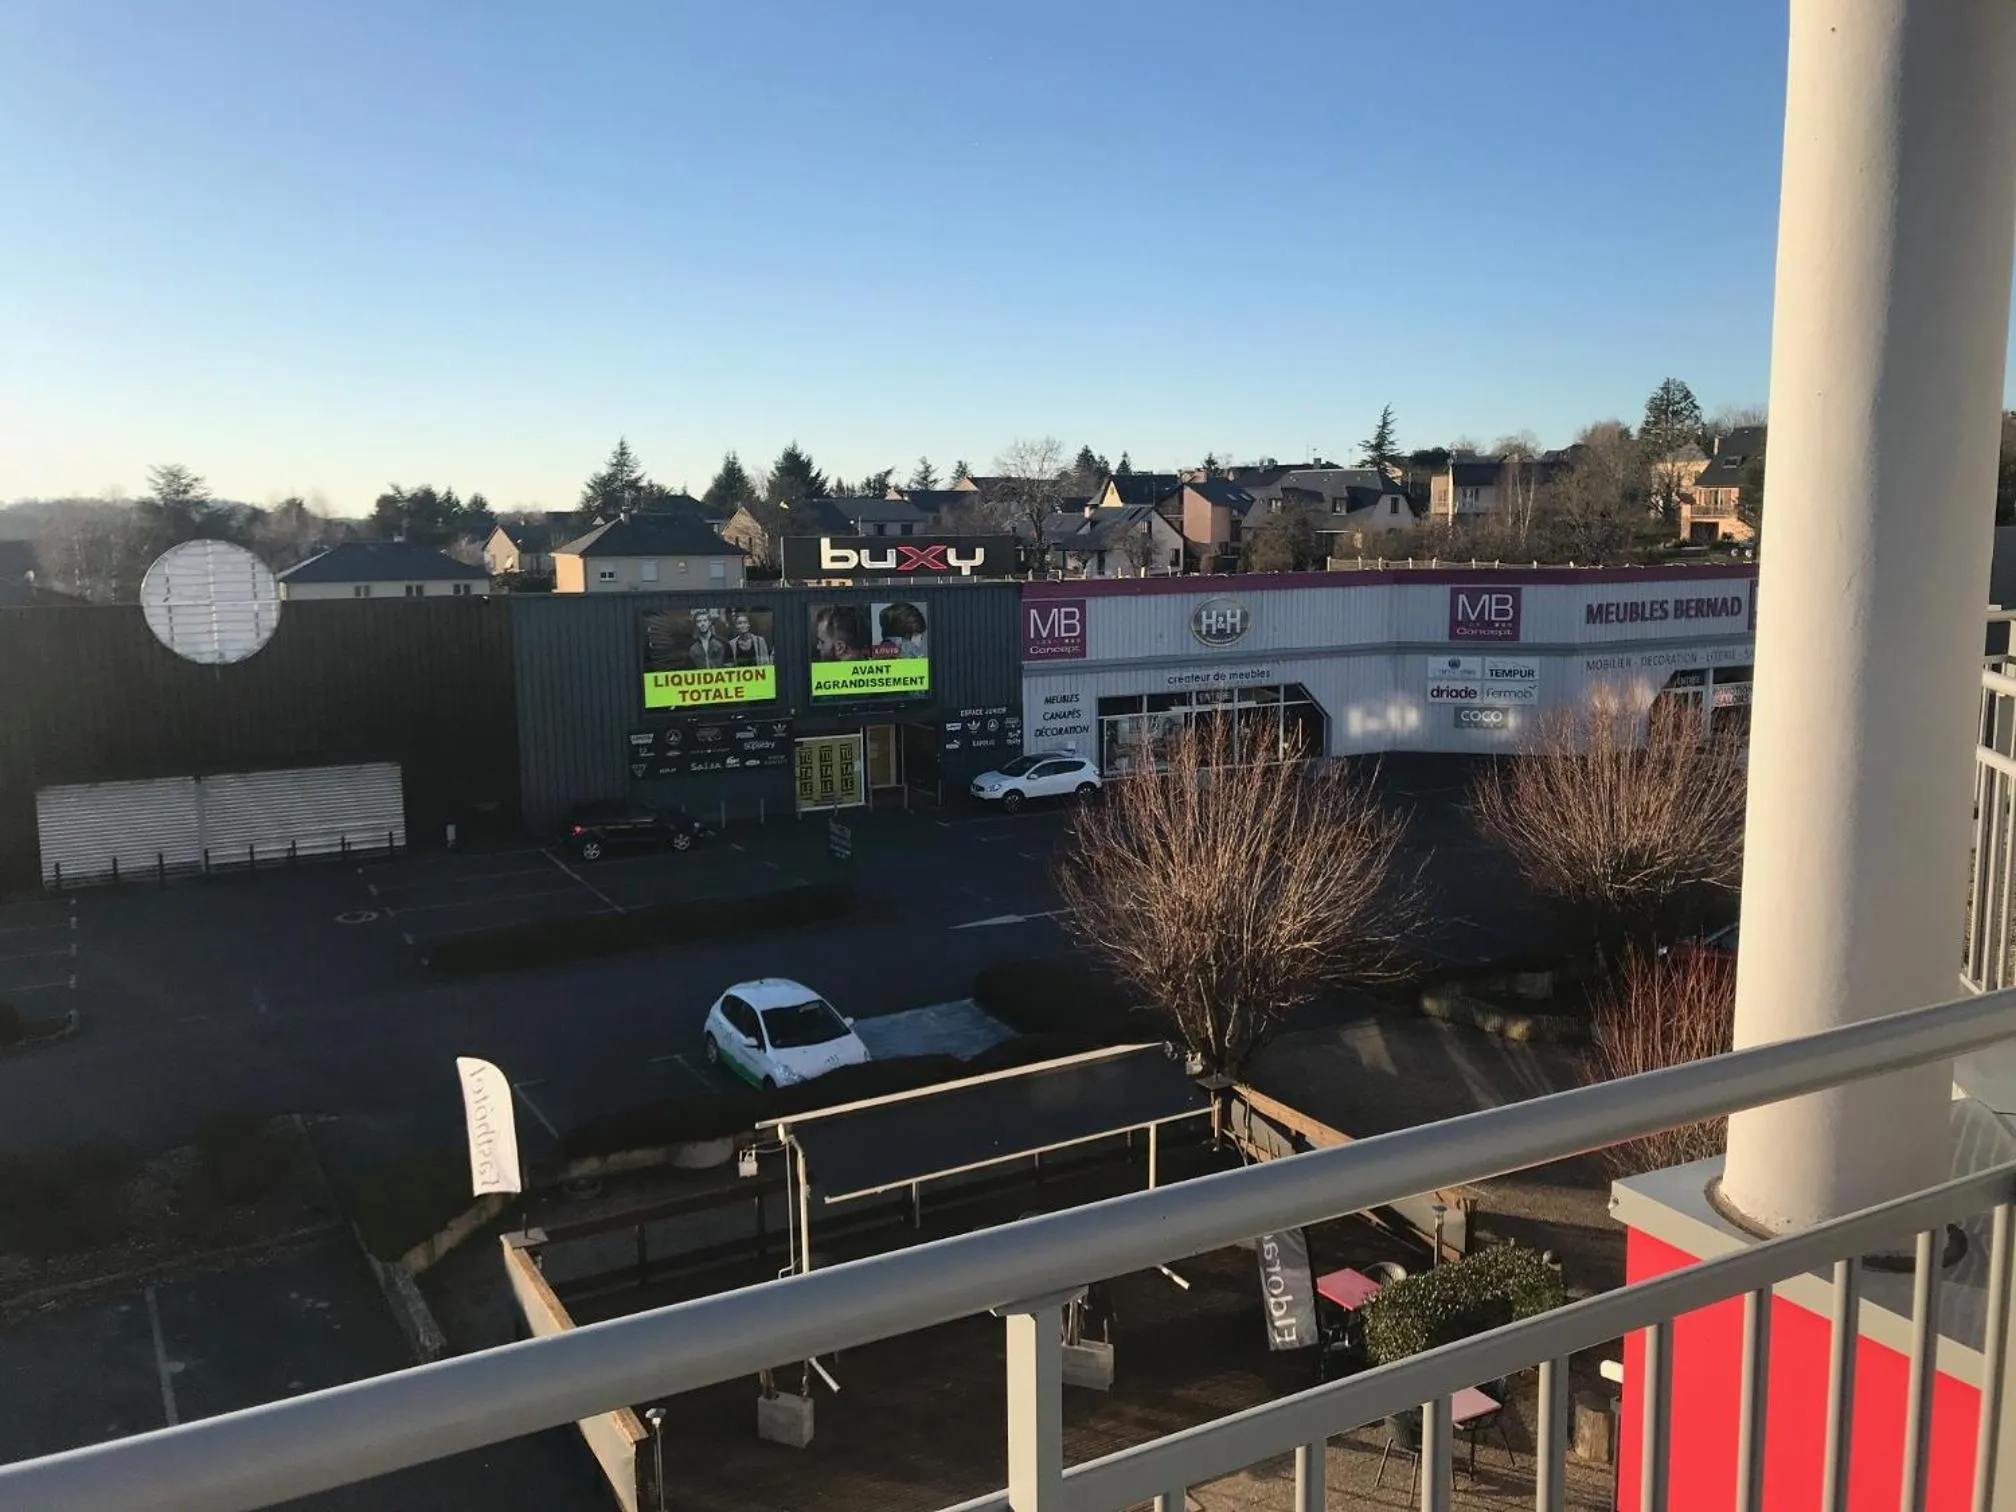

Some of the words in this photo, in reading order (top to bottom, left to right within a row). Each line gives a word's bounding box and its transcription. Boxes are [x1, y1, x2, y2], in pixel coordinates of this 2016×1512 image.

[1458, 593, 1514, 621] MB
[1587, 600, 1668, 624] MEUBLES
[1674, 596, 1742, 620] BERNAD
[1030, 607, 1080, 639] MB
[851, 664, 892, 676] AVANT
[1586, 656, 1631, 672] MOBILIER
[653, 668, 767, 688] LIQUIDATION
[1213, 671, 1227, 681] de
[1229, 668, 1271, 681] meubles
[1488, 668, 1535, 678] TEMPUR
[814, 675, 926, 691] AGRANDISSEMENT
[678, 686, 745, 703] TOTALE
[1044, 693, 1080, 705] MEUBLES
[1430, 684, 1478, 699] driade
